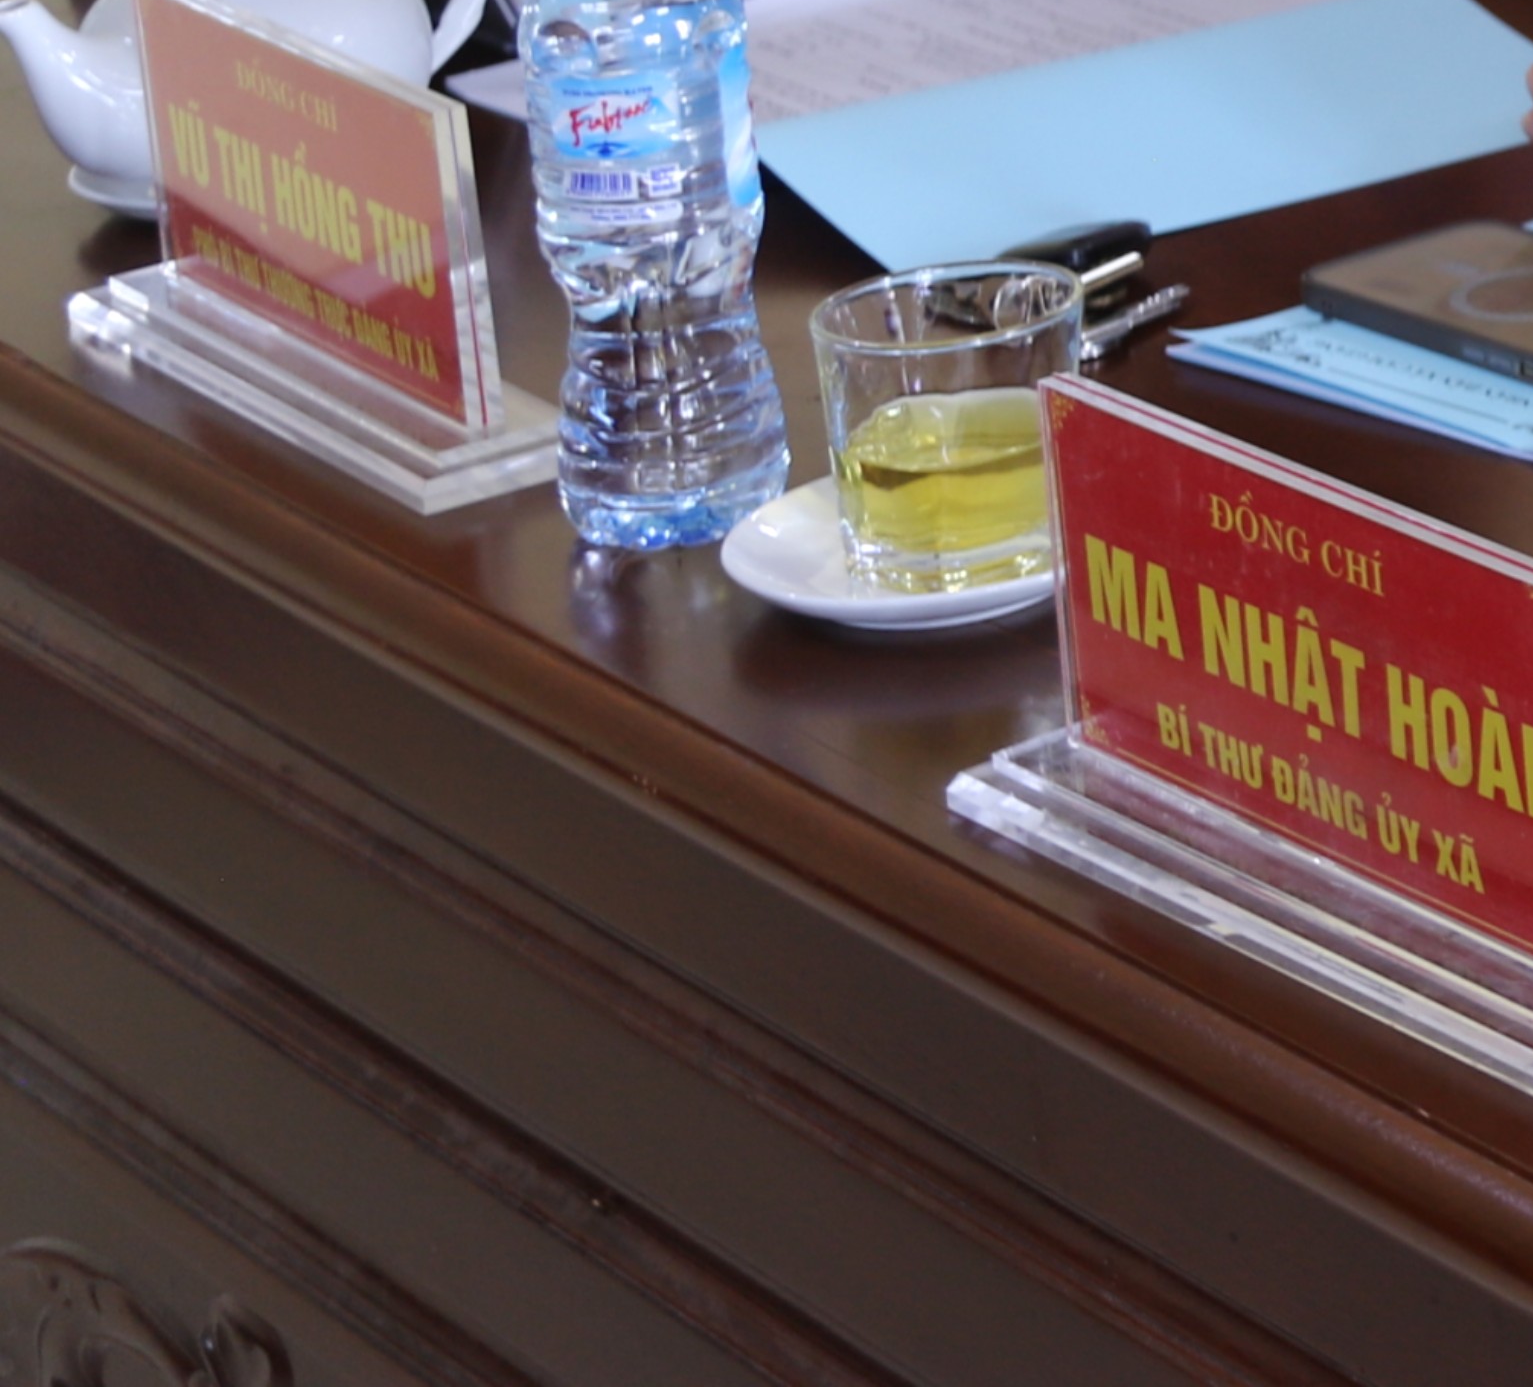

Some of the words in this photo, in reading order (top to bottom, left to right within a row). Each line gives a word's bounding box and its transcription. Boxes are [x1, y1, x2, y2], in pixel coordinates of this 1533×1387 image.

[213, 123, 267, 234] THỊ
[1209, 490, 1312, 567] ĐỒNG
[1320, 548, 1386, 598] CHÍ
[1084, 533, 1185, 662] MA
[1197, 583, 1366, 741] NHẬT
[1156, 703, 1192, 759] BÍ
[1198, 720, 1268, 790] THƯ
[1271, 751, 1368, 841] ĐẢNG
[1376, 791, 1422, 864] ỦY
[1431, 829, 1485, 895] XÃ
